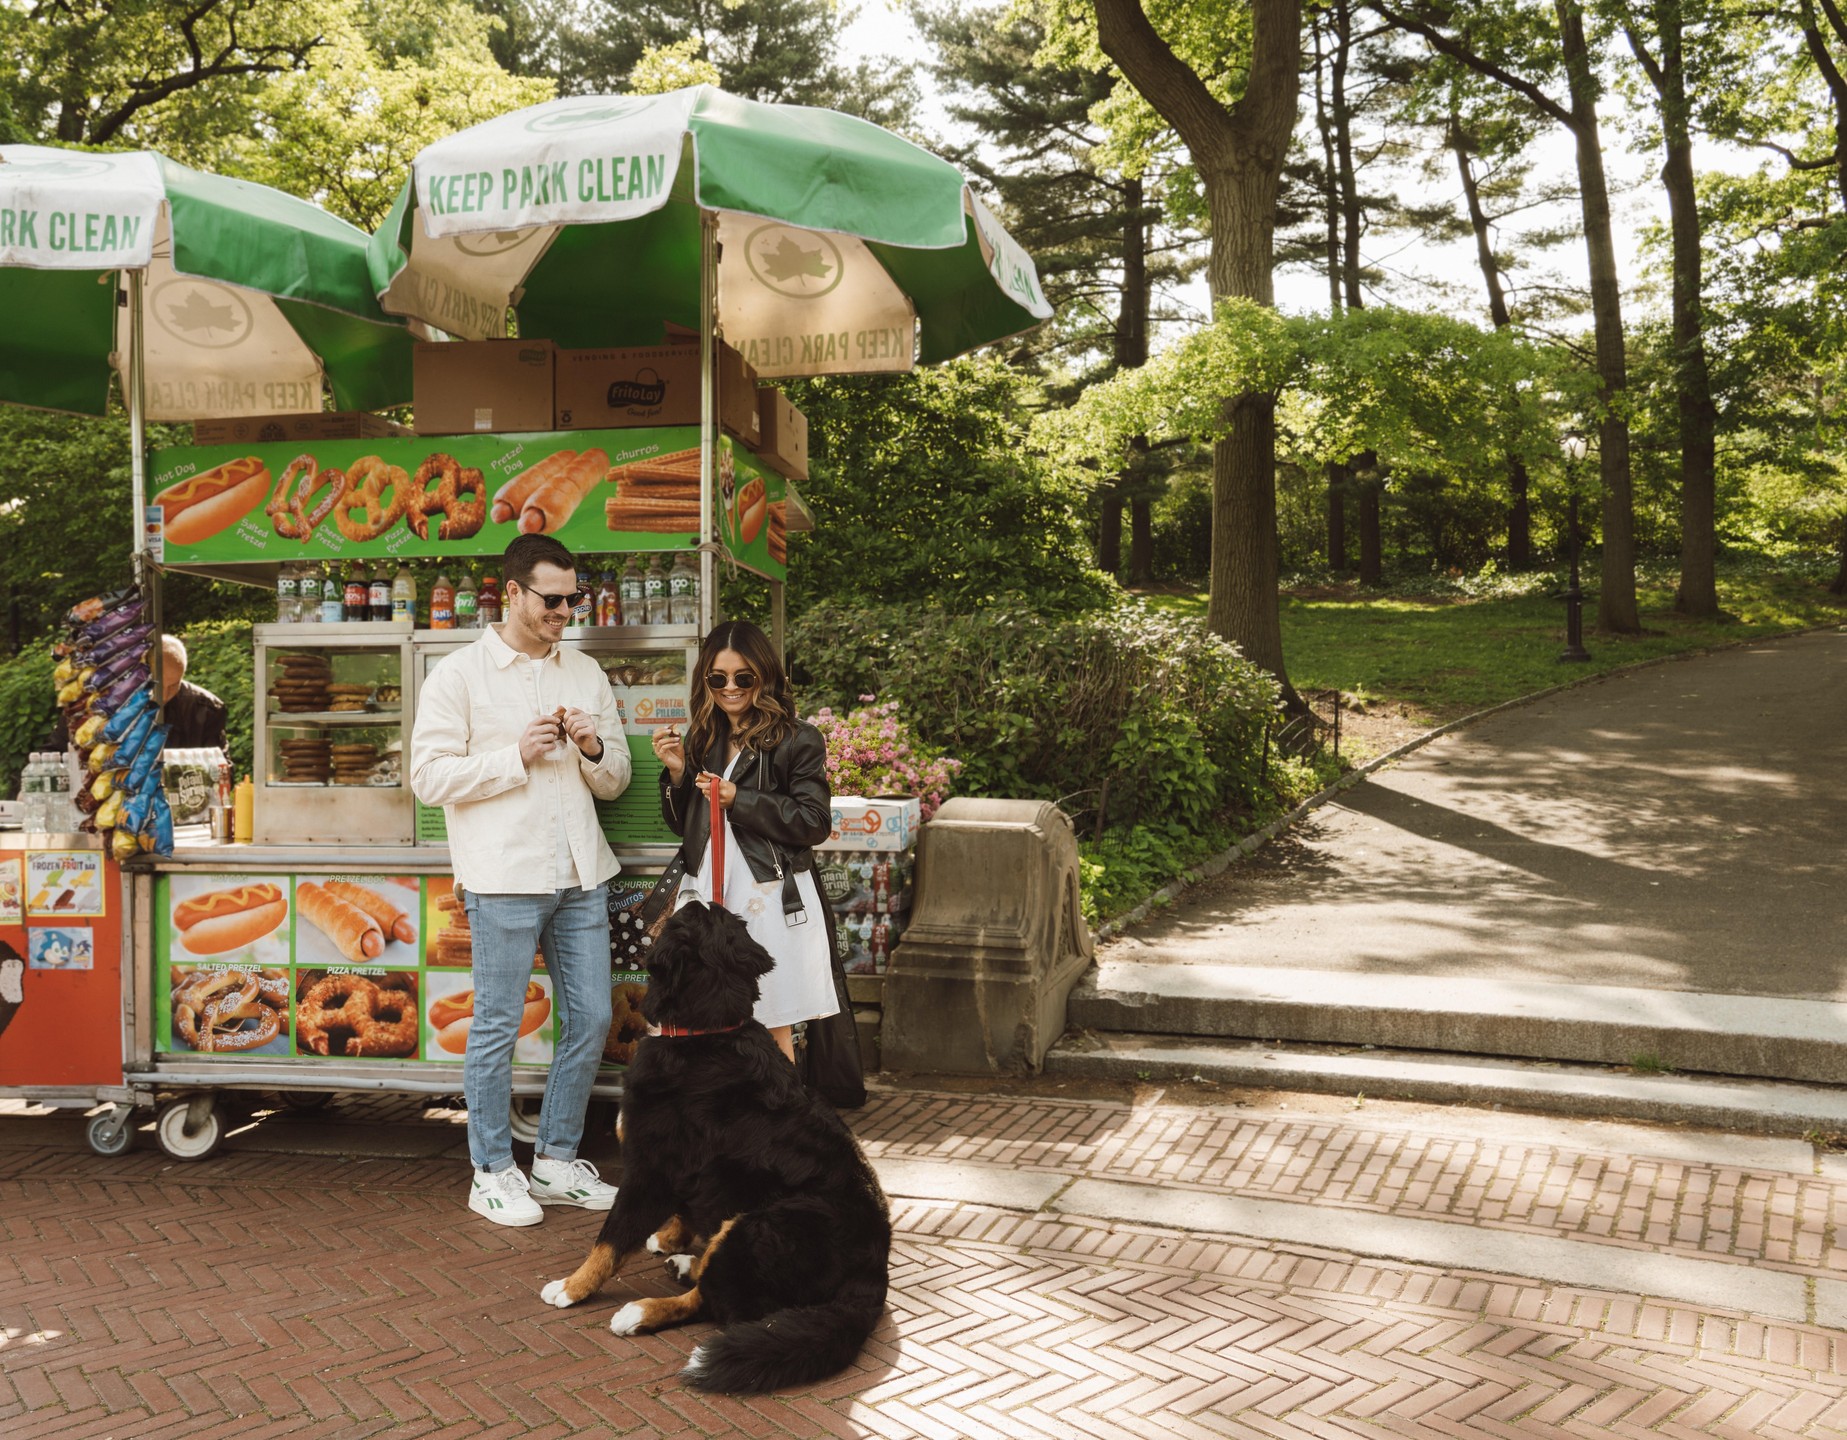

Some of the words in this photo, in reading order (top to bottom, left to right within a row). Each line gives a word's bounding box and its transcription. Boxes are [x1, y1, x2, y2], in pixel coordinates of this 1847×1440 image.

[429, 172, 494, 215] KEEP
[502, 161, 568, 210] PARK
[578, 155, 665, 202] CLEAN
[0, 208, 39, 249] RK
[49, 210, 141, 251] CLEAN
[572, 353, 616, 363] VENDING
[632, 349, 700, 360] FOODSERVICE
[626, 406, 645, 416] Good
[490, 443, 525, 471] Pretzel
[615, 443, 660, 463] churros
[154, 470, 175, 486] Hot
[175, 462, 197, 477] Dog
[503, 458, 524, 476] Dog
[240, 518, 270, 539] Salted
[319, 524, 346, 545] Cheese
[384, 526, 406, 542] Pizza
[236, 528, 267, 549] Pretzel
[315, 532, 342, 553] Pretzel
[386, 531, 414, 553] Pretzel
[573, 604, 592, 614] apple
[33, 861, 61, 871] FROZEN
[61, 860, 84, 870] FRUIT
[329, 874, 365, 884] PRETZEL
[367, 875, 386, 884] DOG
[820, 870, 848, 882] oland
[823, 881, 850, 891] ring
[609, 890, 644, 913] Churros
[197, 962, 228, 973] SALTED
[228, 963, 263, 973] PRETZEL
[327, 966, 350, 975] PIZZA
[351, 966, 388, 977] PRETZEL
[624, 973, 650, 982] PRET
